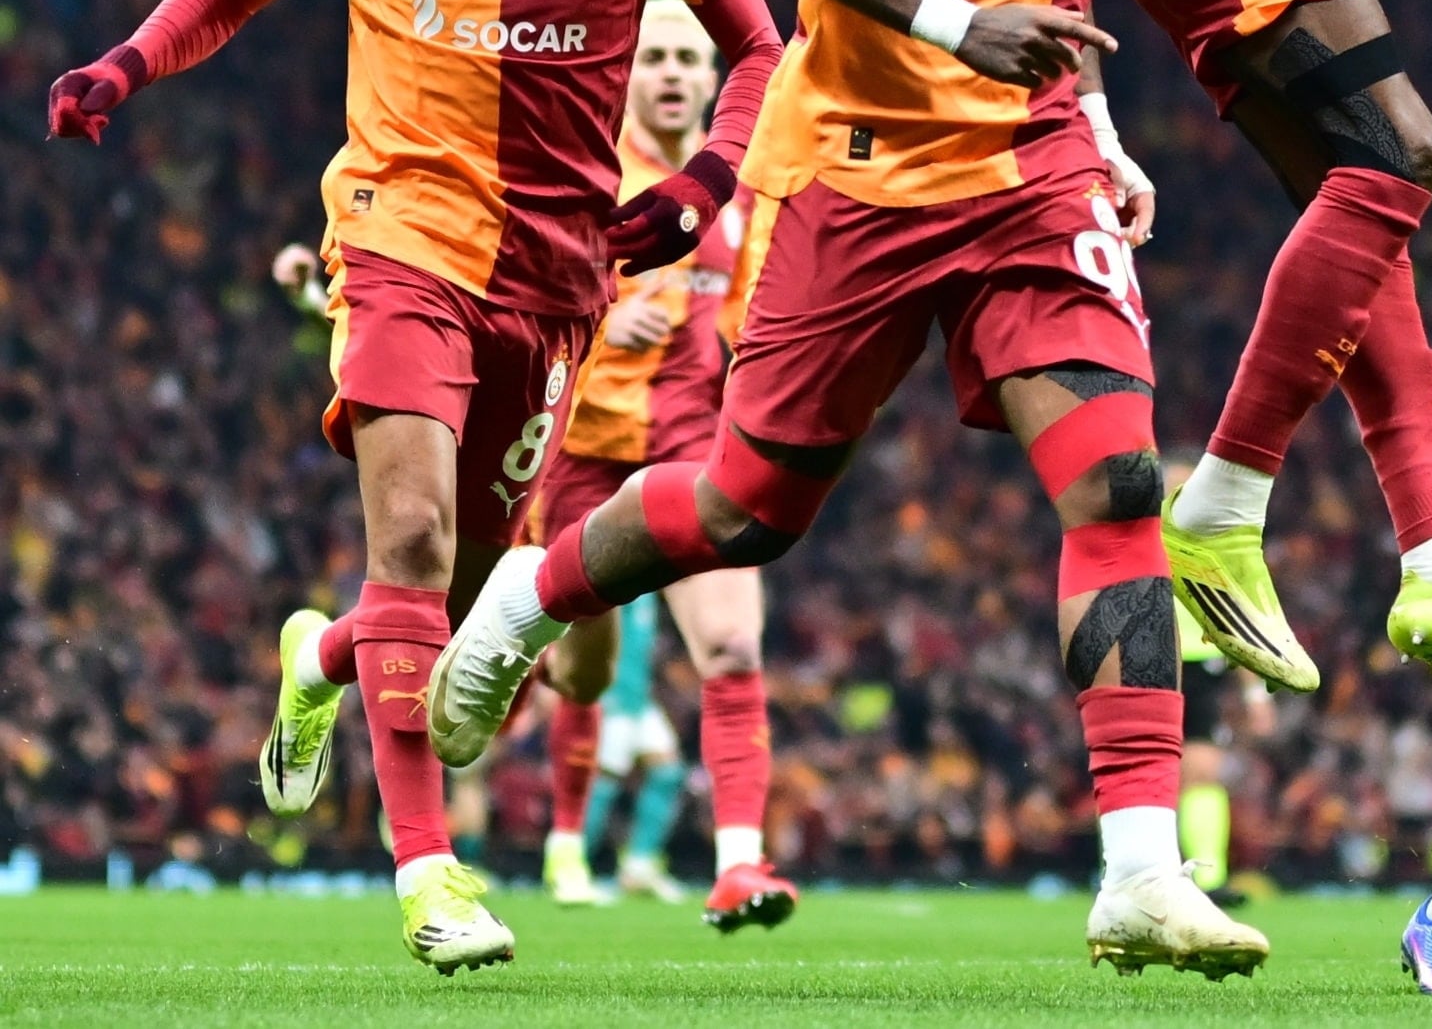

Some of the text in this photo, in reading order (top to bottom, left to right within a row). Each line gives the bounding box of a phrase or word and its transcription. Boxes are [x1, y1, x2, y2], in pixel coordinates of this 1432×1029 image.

[452, 19, 588, 53] SOCAR
[502, 412, 554, 482] 8
[382, 659, 417, 675] GS
